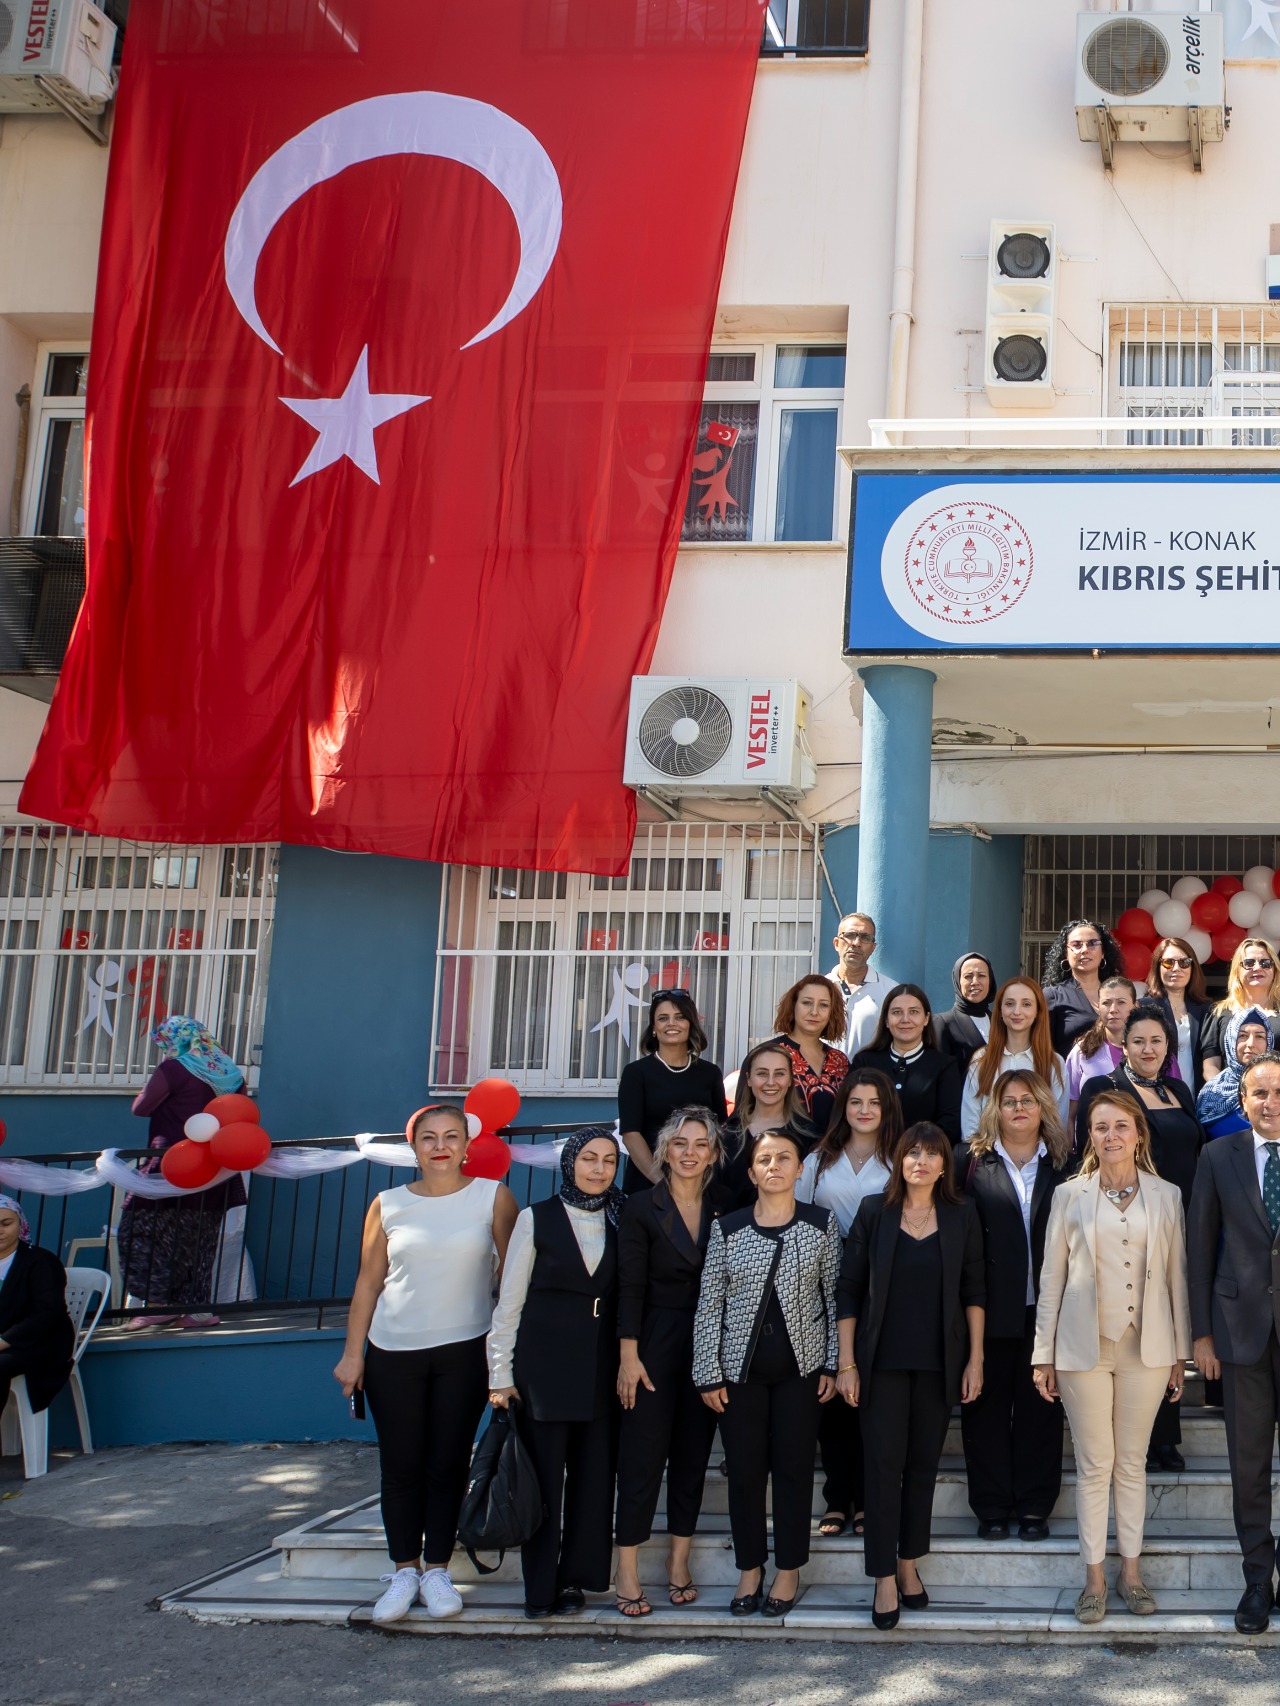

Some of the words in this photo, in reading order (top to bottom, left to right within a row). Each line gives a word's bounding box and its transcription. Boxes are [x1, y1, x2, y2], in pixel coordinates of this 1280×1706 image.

[1182, 15, 1205, 75] arçelik
[928, 523, 965, 572] CUMHURİYETİ
[967, 523, 992, 535] MİLLİ
[991, 532, 1010, 560] EĞİTİM
[1079, 527, 1147, 551] İZMİR
[1169, 530, 1257, 551] KONAK
[1078, 565, 1186, 591] KIBRIS
[746, 689, 771, 770] VESTEL
